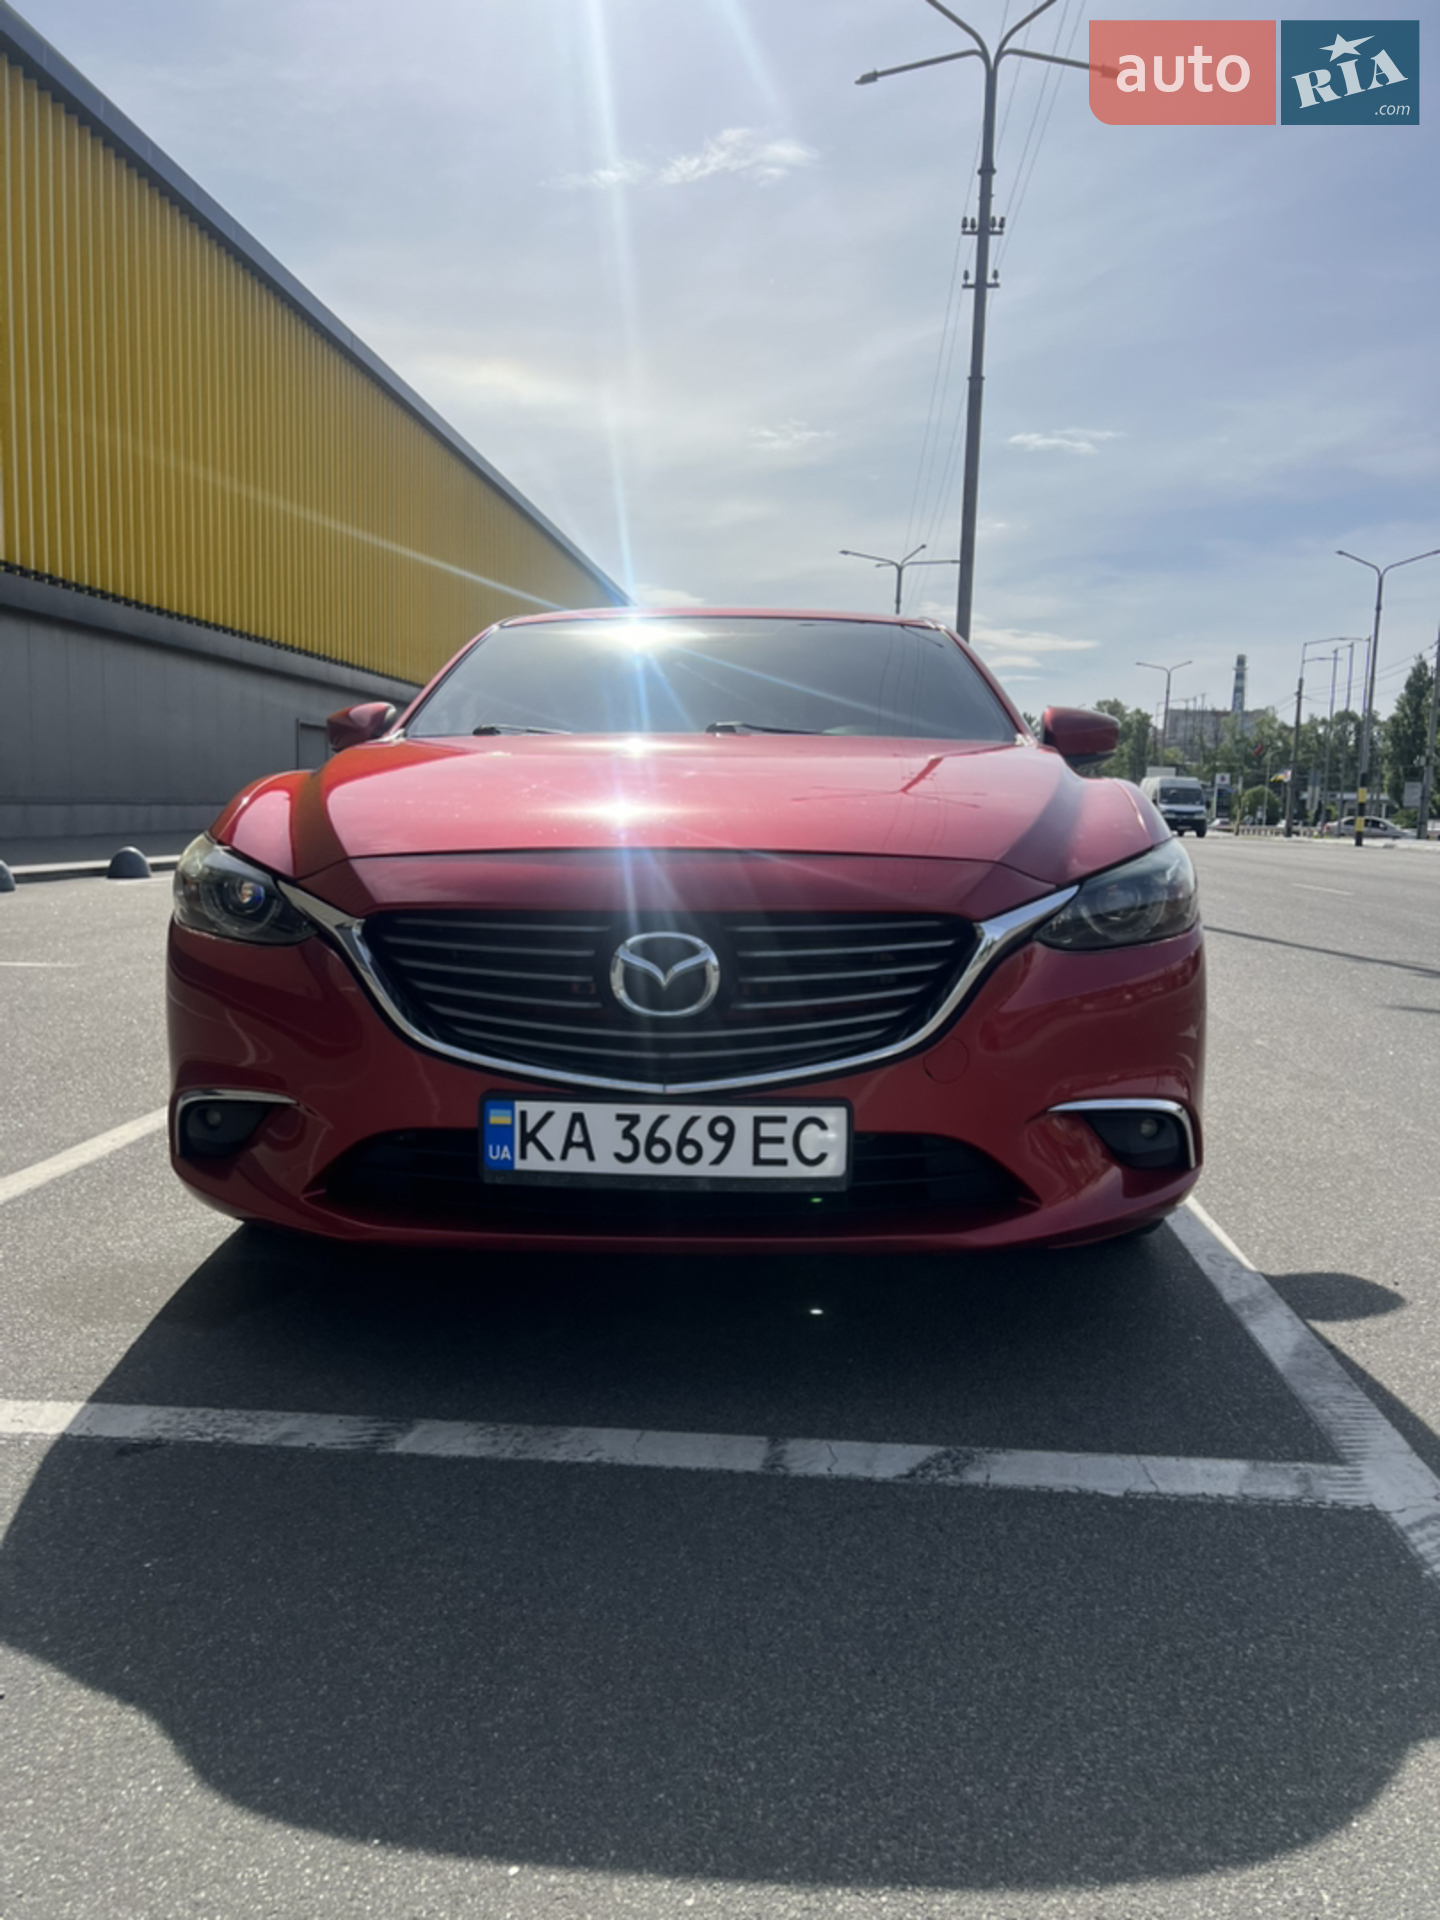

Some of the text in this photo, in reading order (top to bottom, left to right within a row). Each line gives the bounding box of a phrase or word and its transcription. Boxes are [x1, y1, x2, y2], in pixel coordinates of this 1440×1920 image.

[488, 1144, 512, 1161] UA
[518, 1110, 829, 1168] KA 3669 EC
